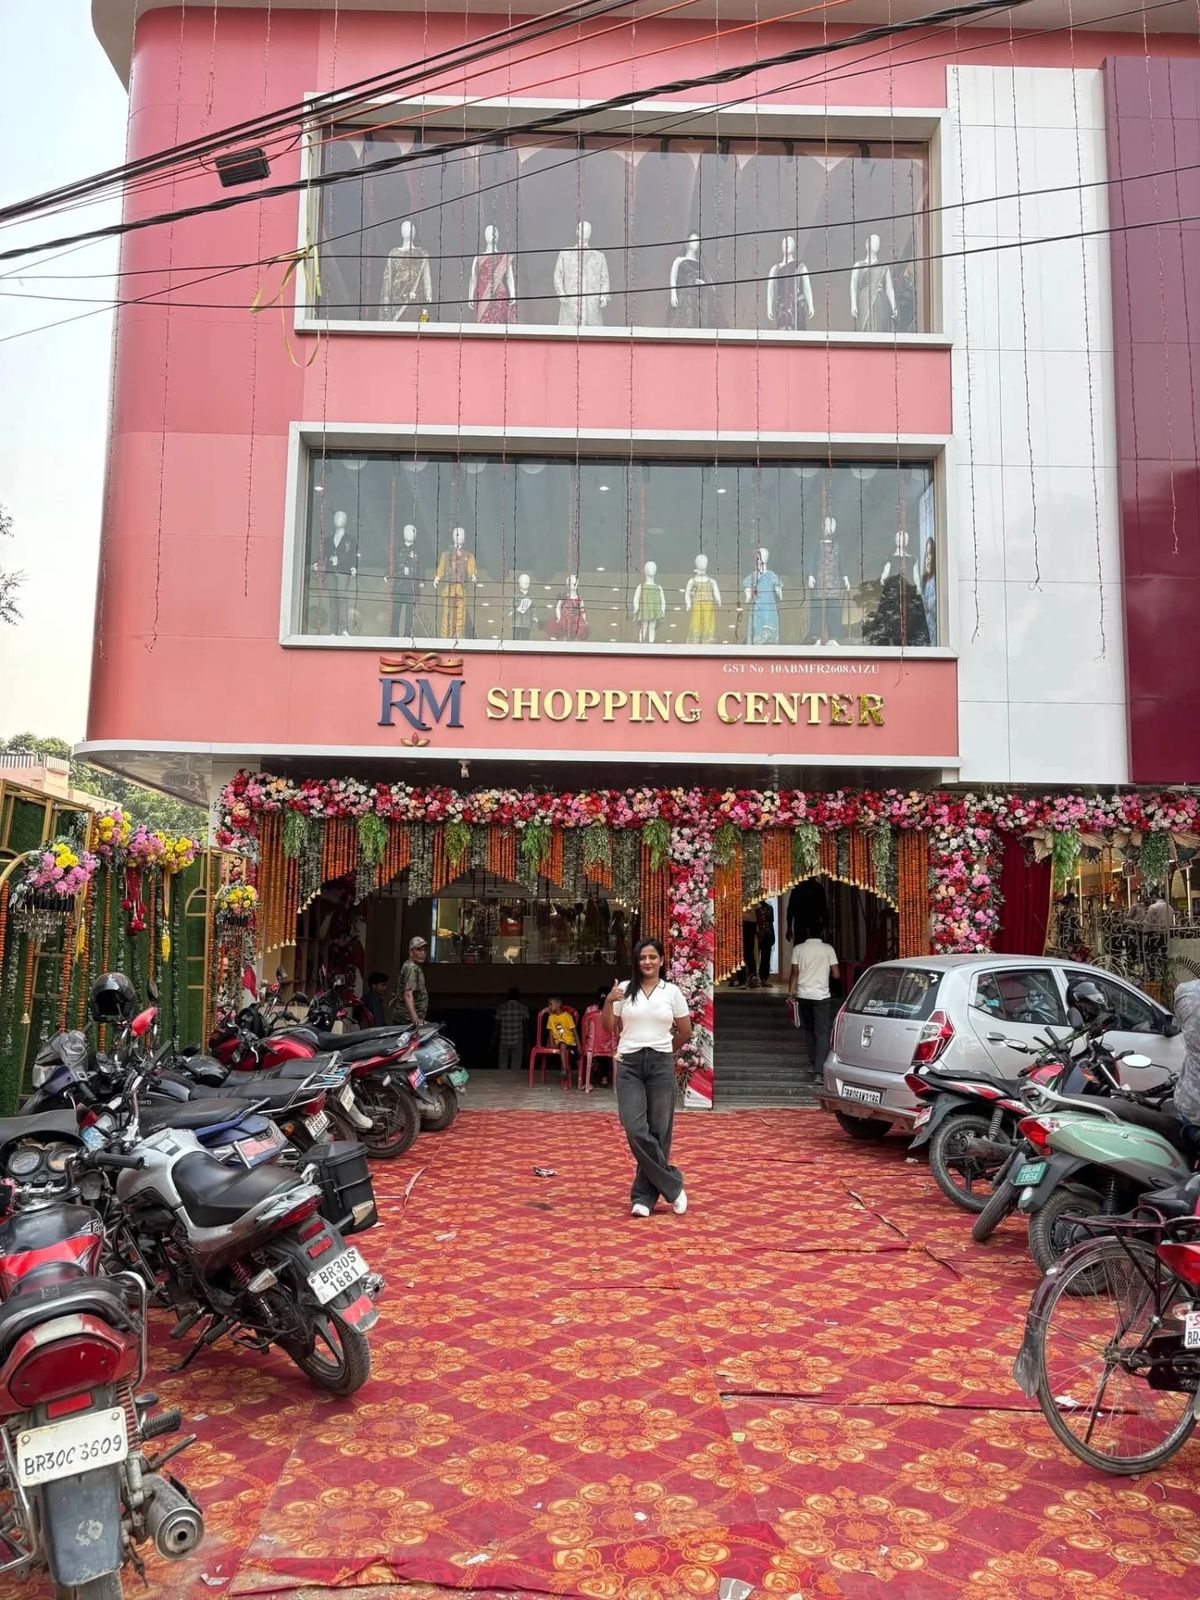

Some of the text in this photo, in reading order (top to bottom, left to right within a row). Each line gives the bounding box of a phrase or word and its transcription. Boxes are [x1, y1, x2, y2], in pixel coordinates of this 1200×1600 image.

[723, 663, 746, 674] GST
[750, 664, 764, 674] No
[377, 677, 885, 731] RM SHOPPING CENTER
[330, 1265, 360, 1293] 1881
